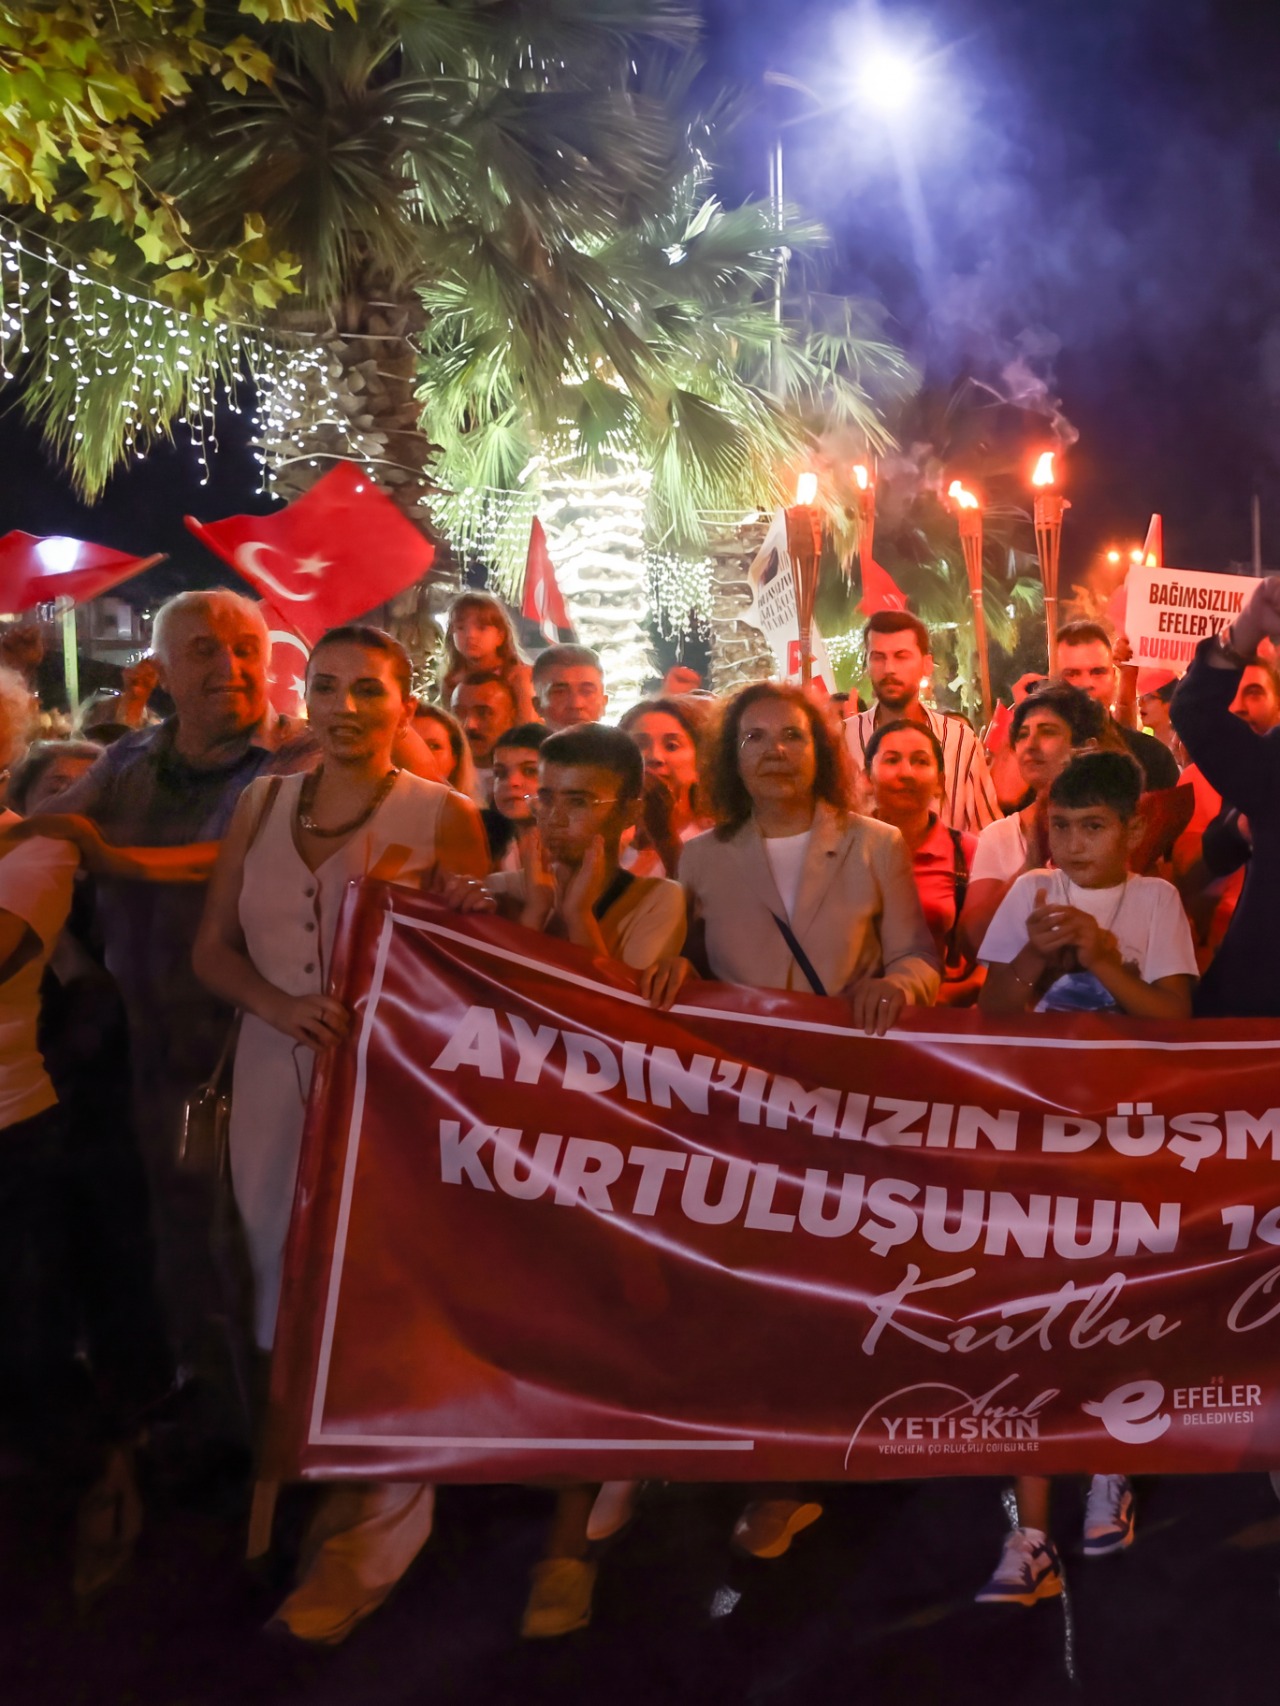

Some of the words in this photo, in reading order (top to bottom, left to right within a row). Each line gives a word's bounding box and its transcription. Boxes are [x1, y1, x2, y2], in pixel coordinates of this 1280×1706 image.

[1149, 581, 1244, 613] BAĞIMSIZLIK
[430, 1005, 1020, 1151] AYDIN'IMIZIN
[439, 1119, 1181, 1259] KURTULUŞUNUN
[861, 1264, 1181, 1356] Kutlu
[1173, 1384, 1262, 1409] EFELER
